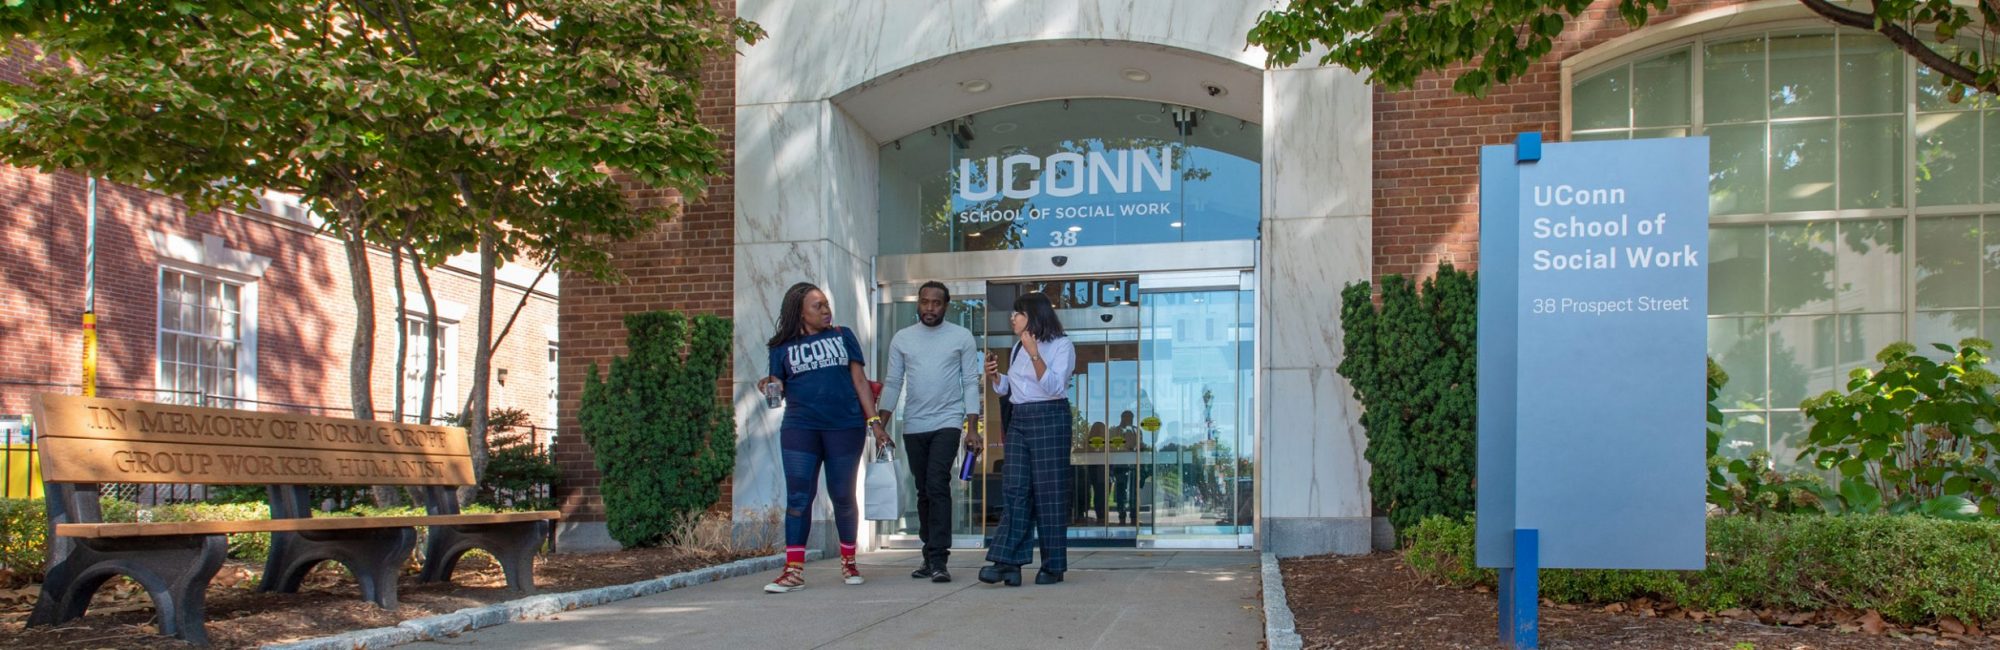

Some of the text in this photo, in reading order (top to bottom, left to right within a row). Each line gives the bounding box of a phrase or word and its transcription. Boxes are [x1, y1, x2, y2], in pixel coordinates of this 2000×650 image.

[960, 148, 1172, 201] UCONN
[1533, 184, 1626, 206] UConn
[959, 202, 1171, 224] SCHOOL OF SOCIAL WORK
[1533, 212, 1666, 239] School of
[1049, 230, 1078, 247] 38
[1533, 244, 1699, 271] Social Work
[1533, 296, 1689, 316] 38 Prospect Street
[788, 336, 849, 367] UCONN
[86, 406, 447, 448] IN MEMORY OF NORM GOROFF
[112, 450, 444, 480] GROUP WORKER, HUMANIST
